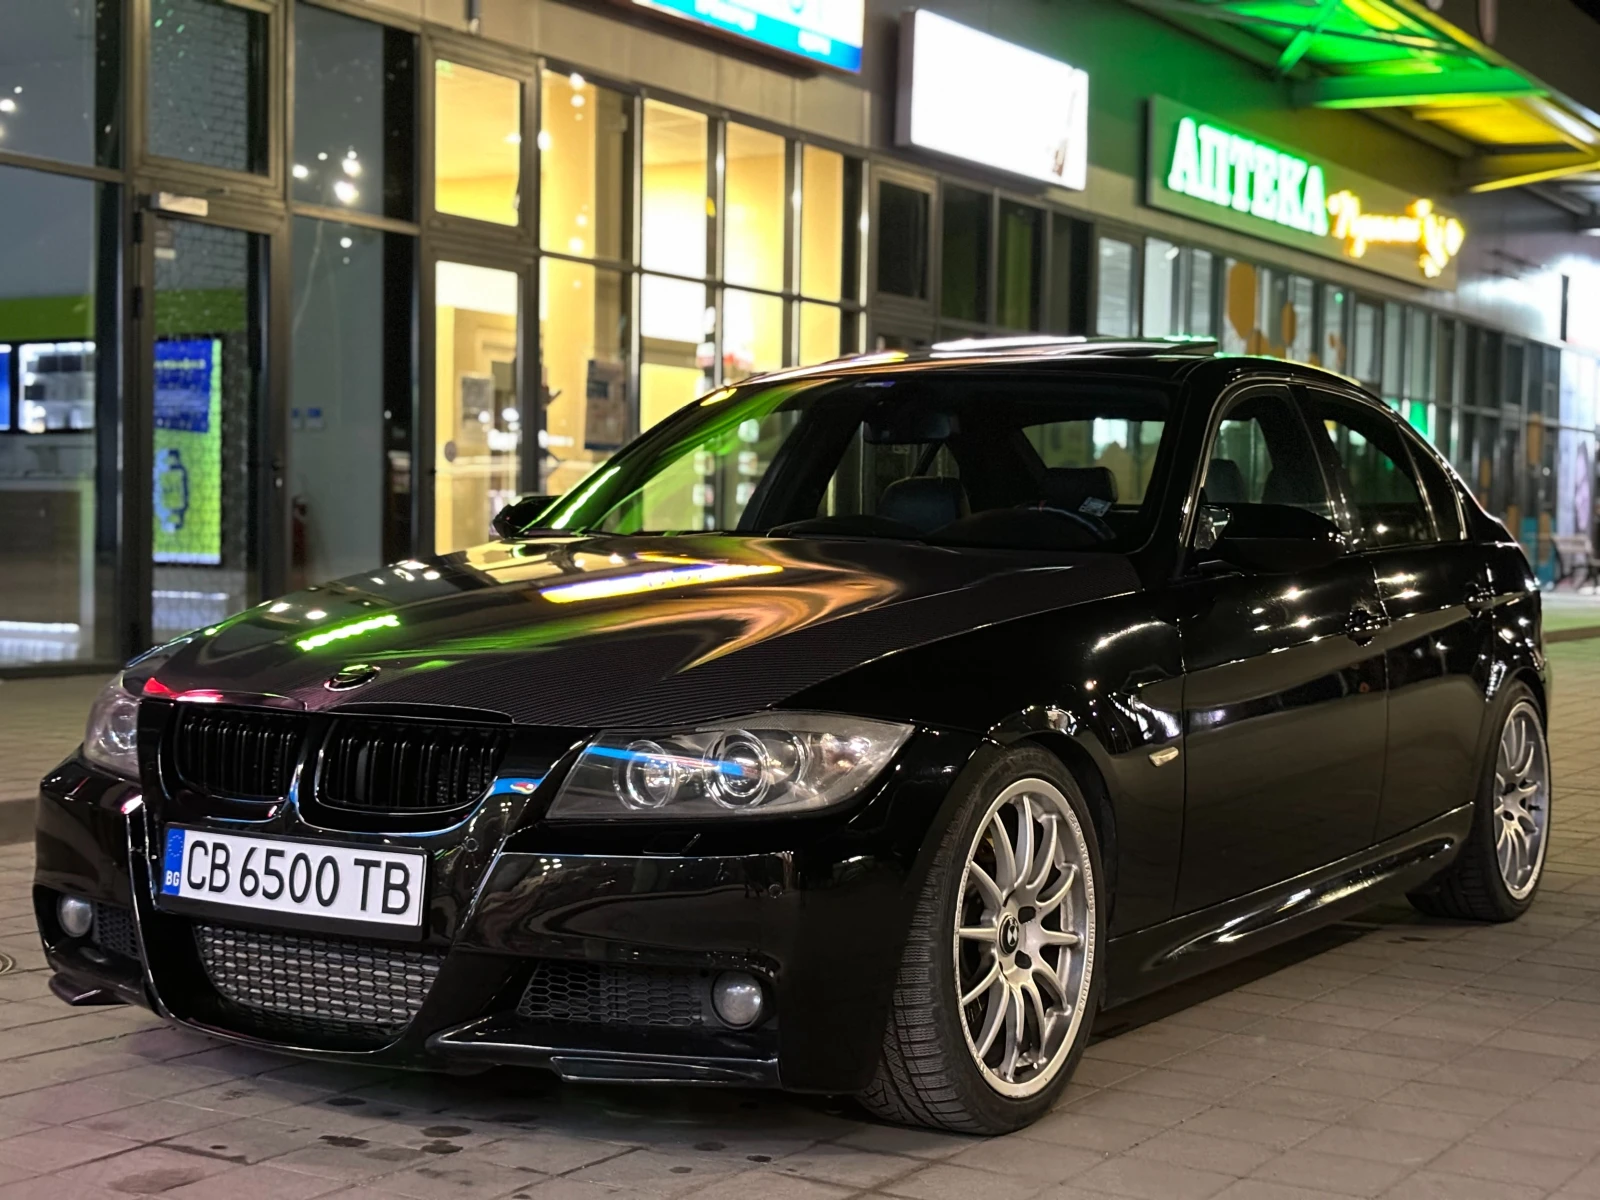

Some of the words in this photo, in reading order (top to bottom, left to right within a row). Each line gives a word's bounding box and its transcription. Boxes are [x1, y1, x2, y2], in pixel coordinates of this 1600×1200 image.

[1168, 116, 1329, 237] АПТЕКА
[165, 870, 180, 887] BG
[187, 840, 232, 893] CB
[239, 846, 340, 907] 6500
[354, 858, 411, 915] TB
